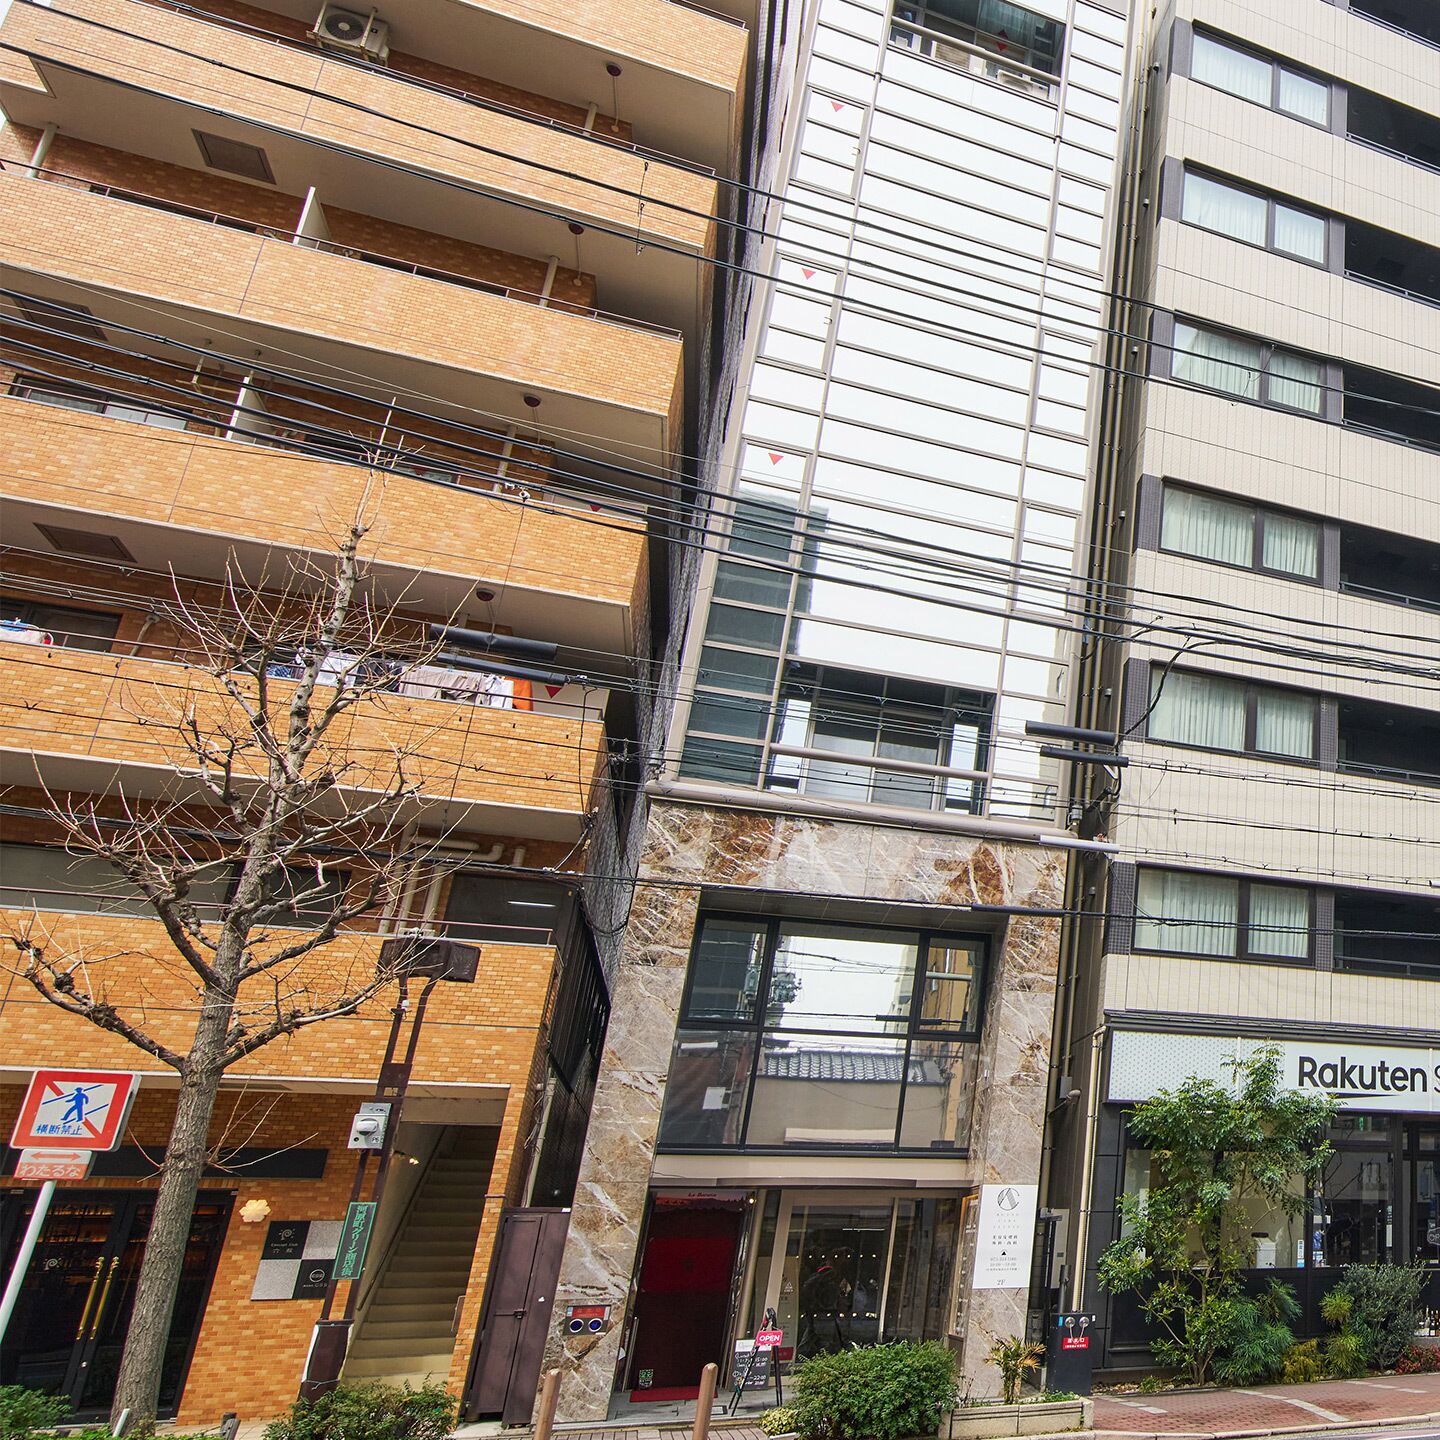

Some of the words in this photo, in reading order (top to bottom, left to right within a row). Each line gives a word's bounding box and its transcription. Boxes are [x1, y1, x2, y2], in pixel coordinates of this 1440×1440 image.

[1298, 1056, 1428, 1093] Rakuten
[36, 1124, 82, 1135] 横断禁止
[17, 1164, 81, 1177] わたるな
